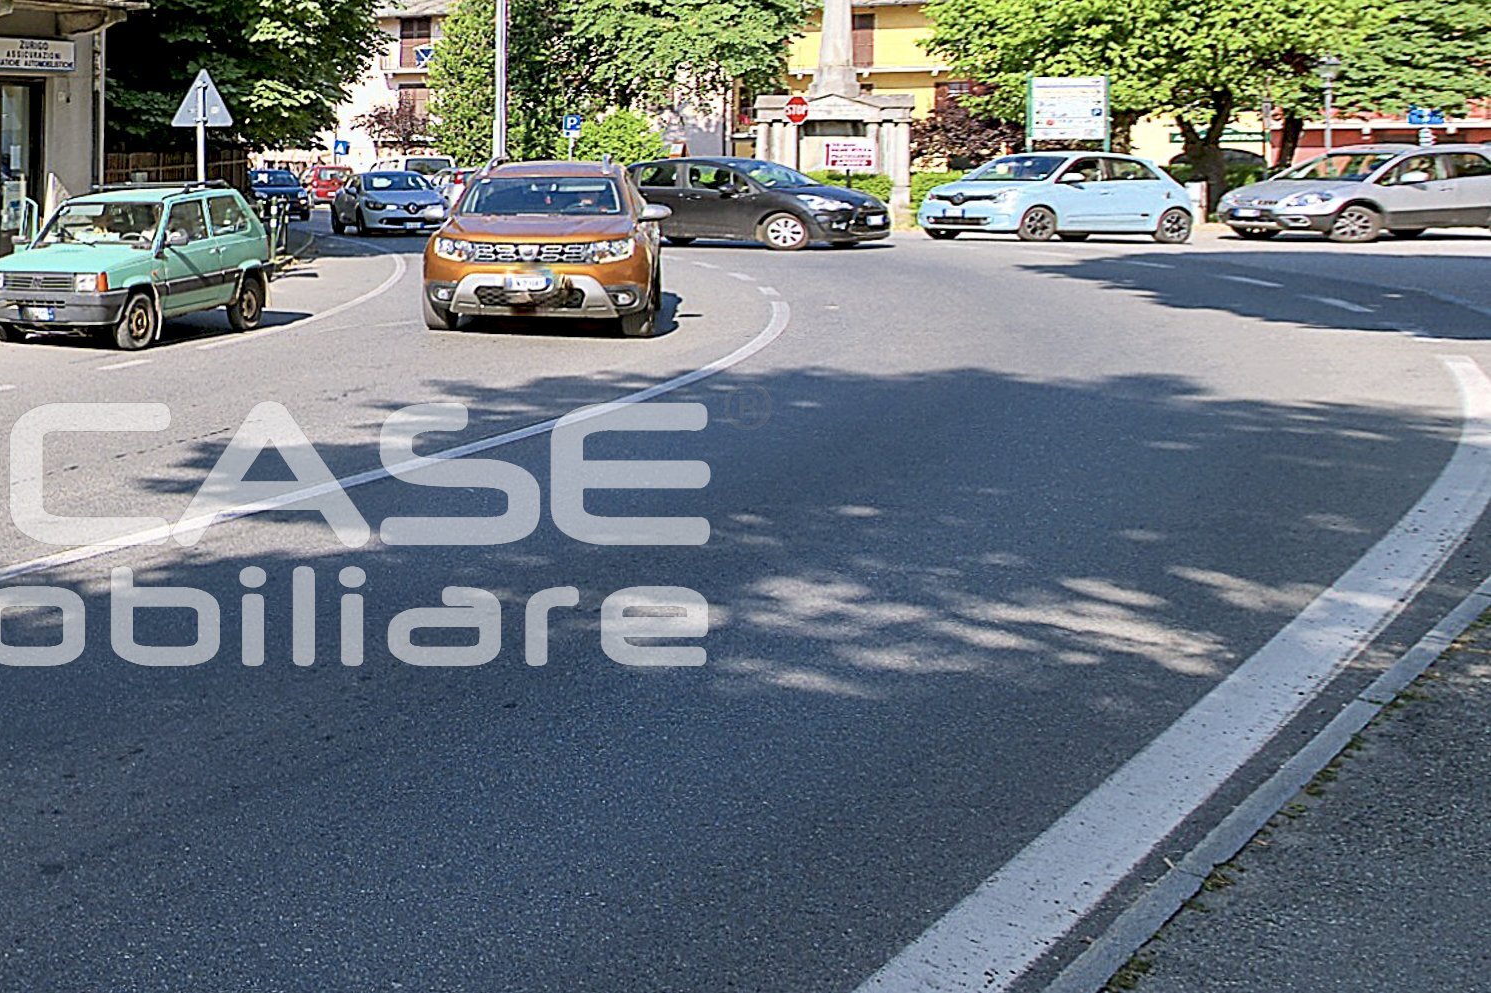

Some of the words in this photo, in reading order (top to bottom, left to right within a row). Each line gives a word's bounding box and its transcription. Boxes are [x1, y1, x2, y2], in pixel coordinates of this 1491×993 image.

[19, 39, 49, 50] ZURIGO
[6, 50, 62, 60] ASSICURAZIONI
[785, 104, 809, 116] STOP
[566, 117, 579, 129] P
